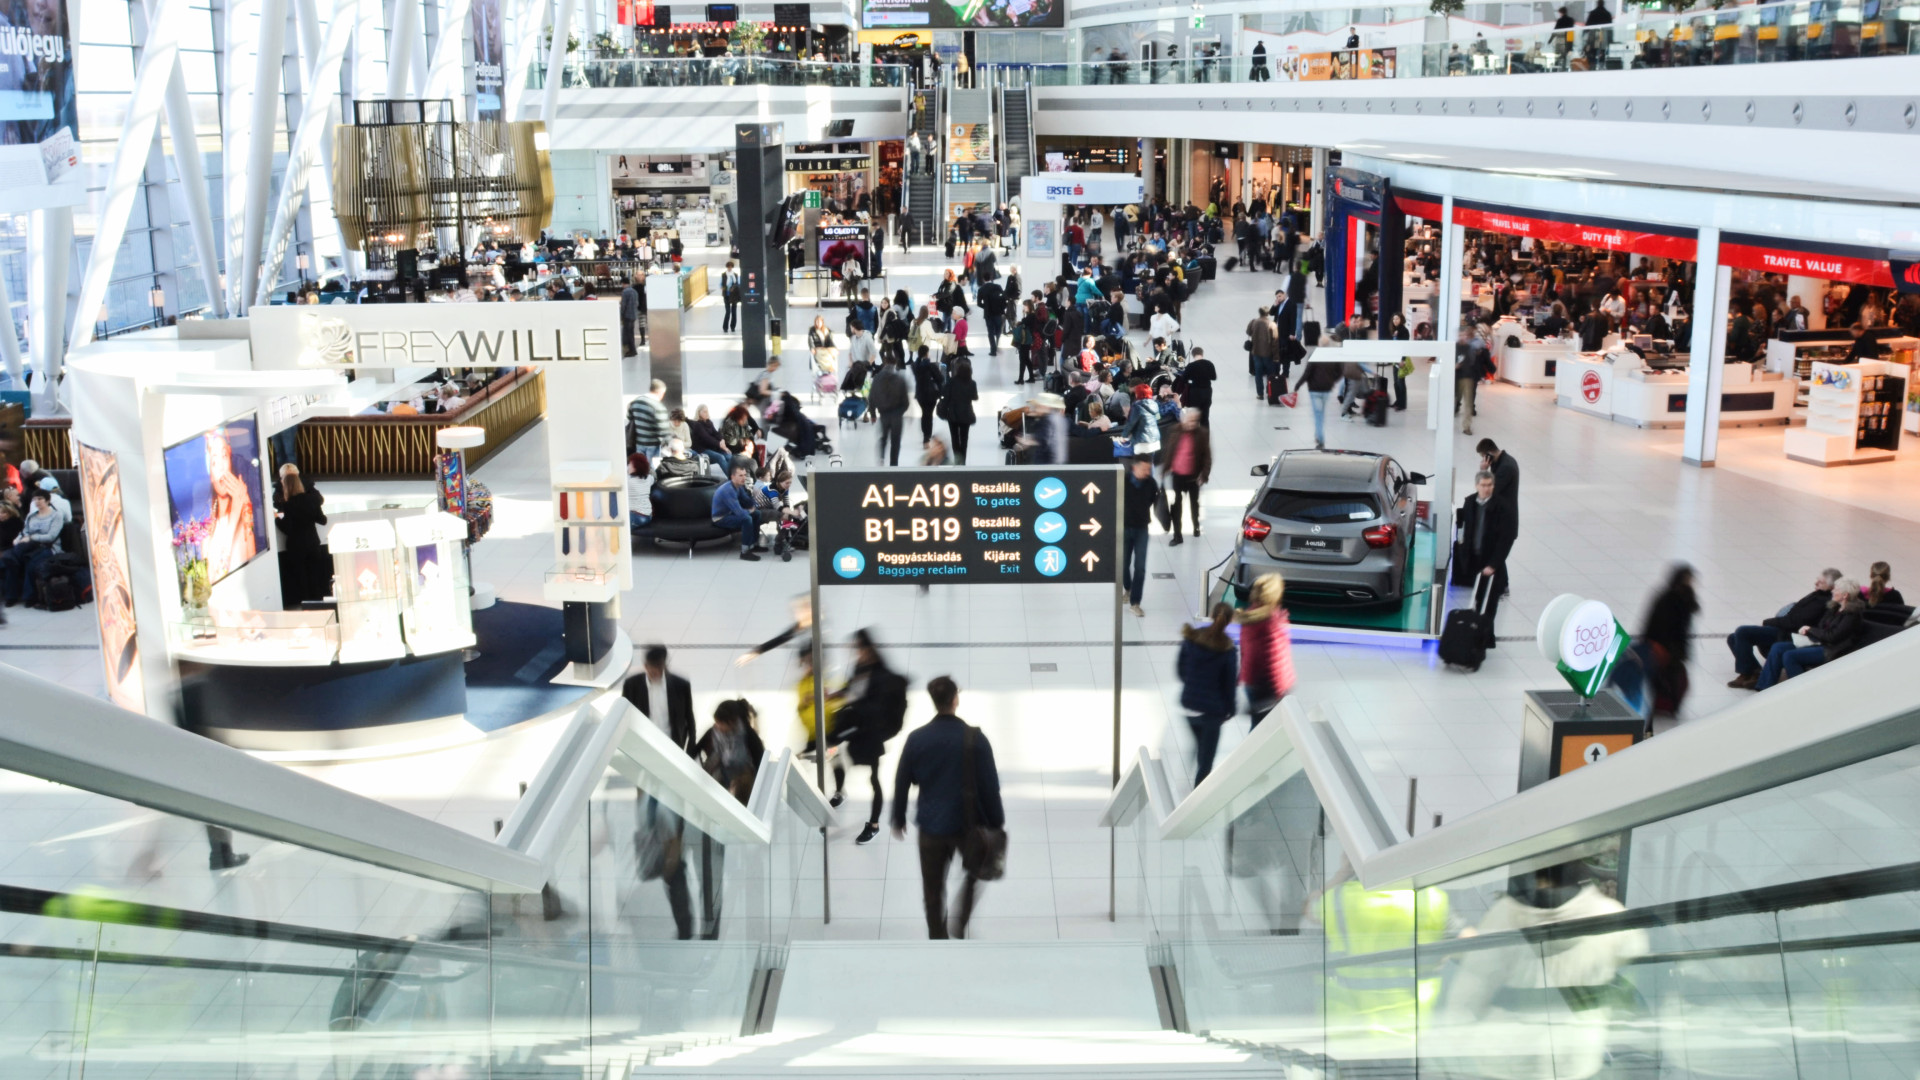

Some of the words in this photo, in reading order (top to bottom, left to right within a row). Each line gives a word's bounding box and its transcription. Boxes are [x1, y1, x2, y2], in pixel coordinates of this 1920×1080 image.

[671, 21, 718, 31] LEROY
[1046, 186, 1072, 195] ERSTE
[1492, 218, 1511, 229] TRAVEL
[1512, 222, 1530, 232] VALUE
[1582, 231, 1601, 242] DUTY
[1604, 235, 1622, 245] FREE
[1763, 254, 1802, 269] TRAVEL
[1806, 260, 1843, 274] VALUE
[355, 328, 609, 364] FREYWILLE
[971, 482, 1021, 493] Beszállás
[975, 496, 988, 506] To
[990, 497, 1021, 508] gates
[972, 517, 1021, 528] Beszállás
[975, 531, 988, 540] To
[991, 531, 1021, 543] gates
[877, 552, 962, 564] Poggyászkiadás
[984, 550, 1021, 564] Kijárat
[878, 566, 925, 577] Baggage
[928, 565, 967, 575] reclaim
[1000, 564, 1020, 574] Exit
[1576, 619, 1608, 642] food
